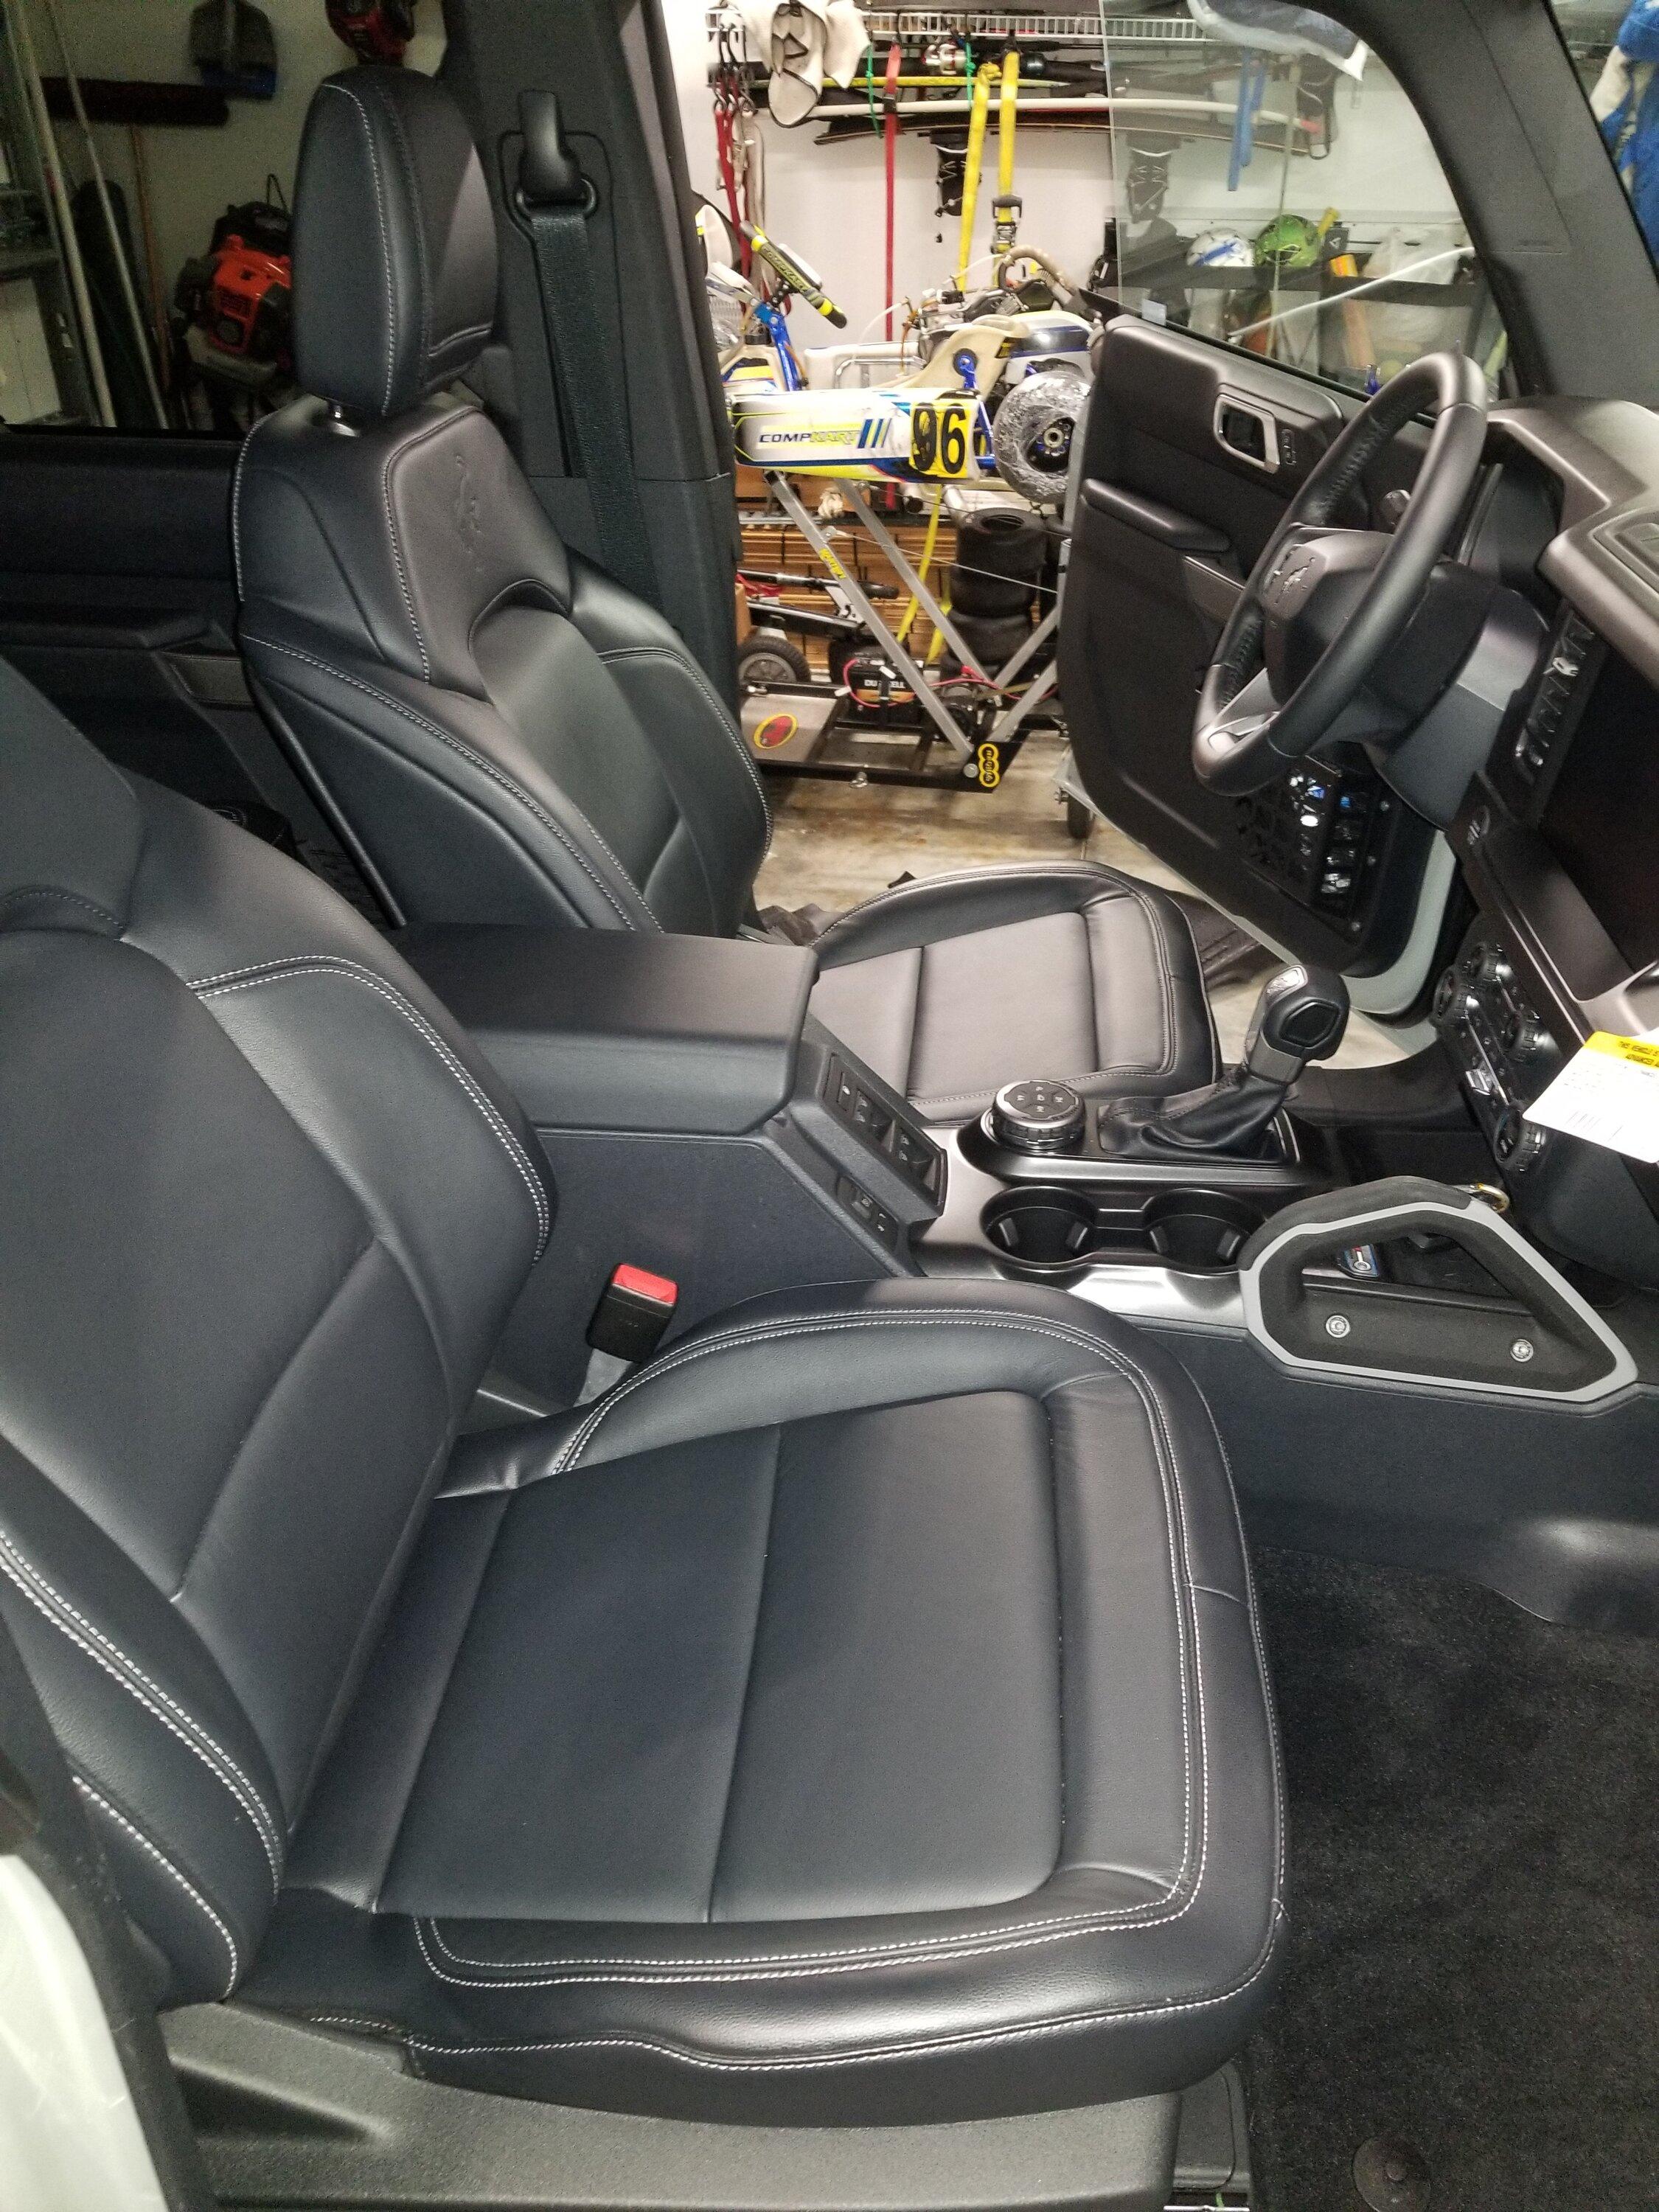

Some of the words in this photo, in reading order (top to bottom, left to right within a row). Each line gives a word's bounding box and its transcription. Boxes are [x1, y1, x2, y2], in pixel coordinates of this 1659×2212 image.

[759, 430, 861, 445] COMPKART
[913, 403, 966, 474] 96
[864, 679, 906, 689] DUELL
